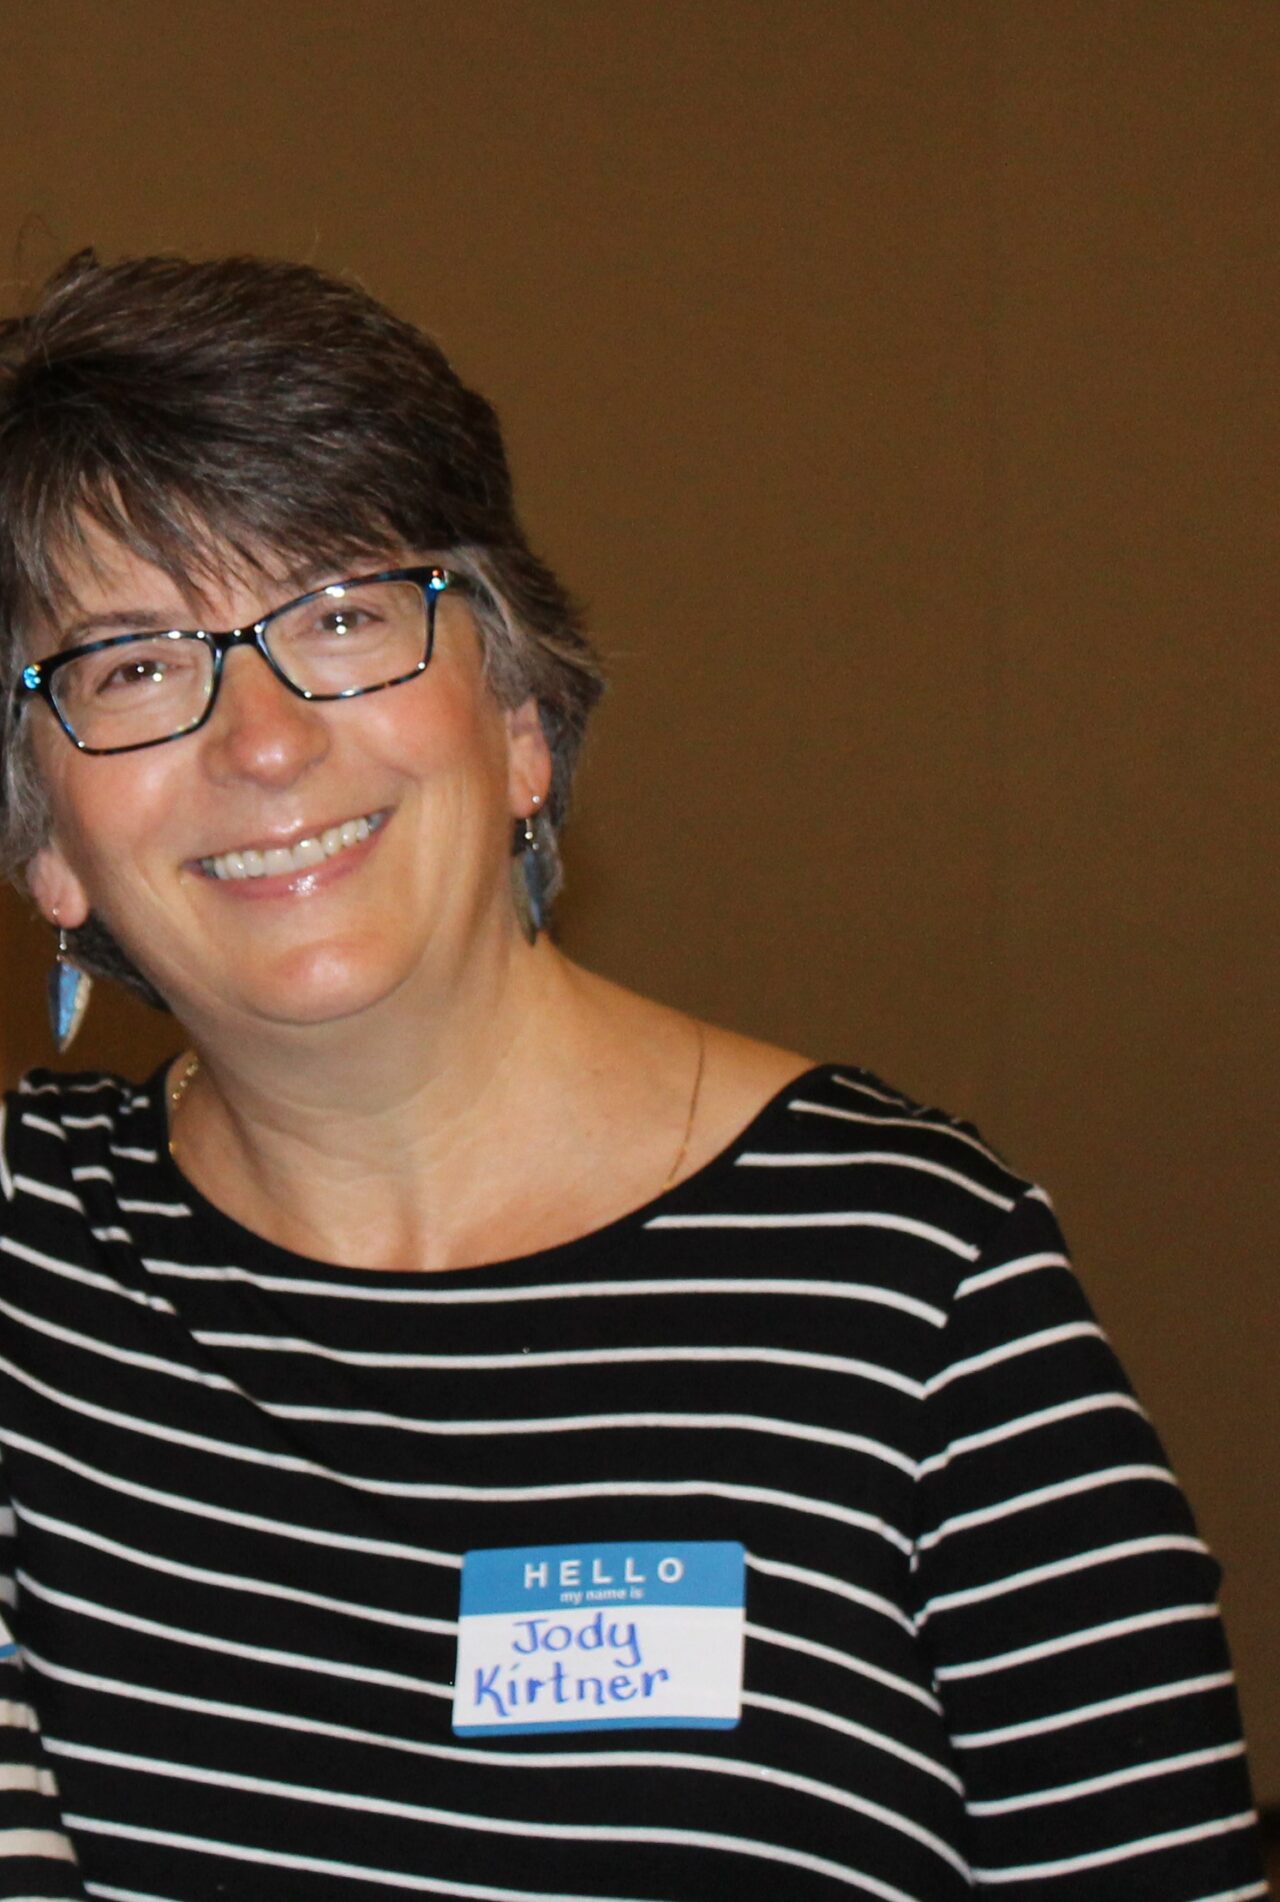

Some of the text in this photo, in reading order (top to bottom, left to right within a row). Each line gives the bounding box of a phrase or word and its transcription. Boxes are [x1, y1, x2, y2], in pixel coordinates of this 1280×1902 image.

[524, 1557, 685, 1589] HELLO
[560, 1586, 644, 1605] my name is
[512, 1611, 642, 1668] Jody
[474, 1661, 671, 1718] Kirtner
